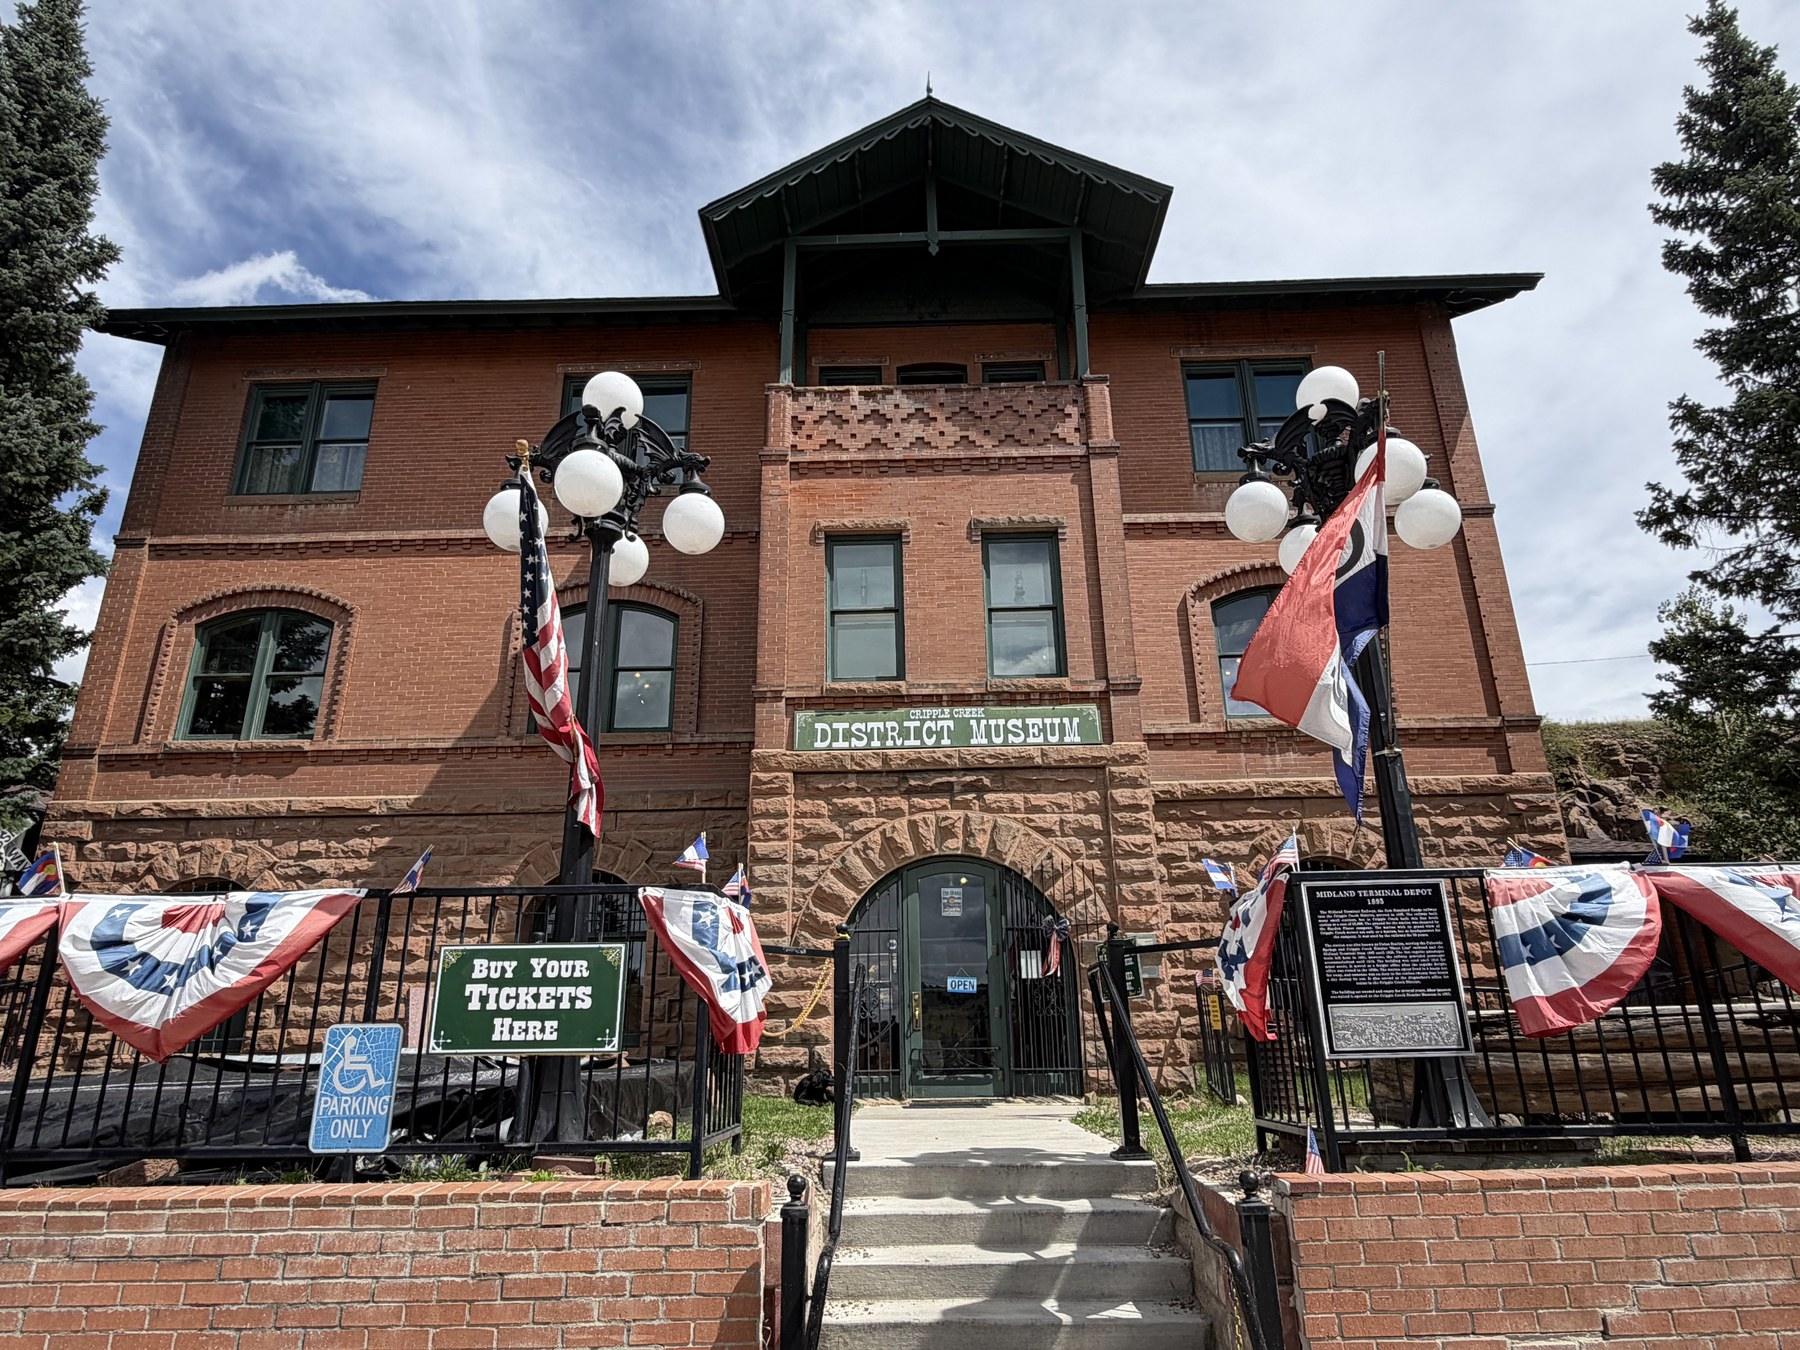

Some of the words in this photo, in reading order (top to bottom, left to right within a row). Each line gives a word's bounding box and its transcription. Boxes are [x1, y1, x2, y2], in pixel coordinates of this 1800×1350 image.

[909, 708, 951, 719] CRIPPLE
[953, 707, 985, 718] CREEK
[813, 719, 955, 748] DISTRICT
[969, 717, 1081, 745] MUSEUM
[1357, 889, 1402, 897] TERMINAL
[1403, 888, 1433, 896] DEPOT
[950, 980, 975, 990] OPEN
[464, 983, 593, 1011] TICKETS
[491, 1017, 559, 1041] HERE
[319, 1096, 389, 1115] PARKING
[330, 1118, 373, 1138] ONLY
